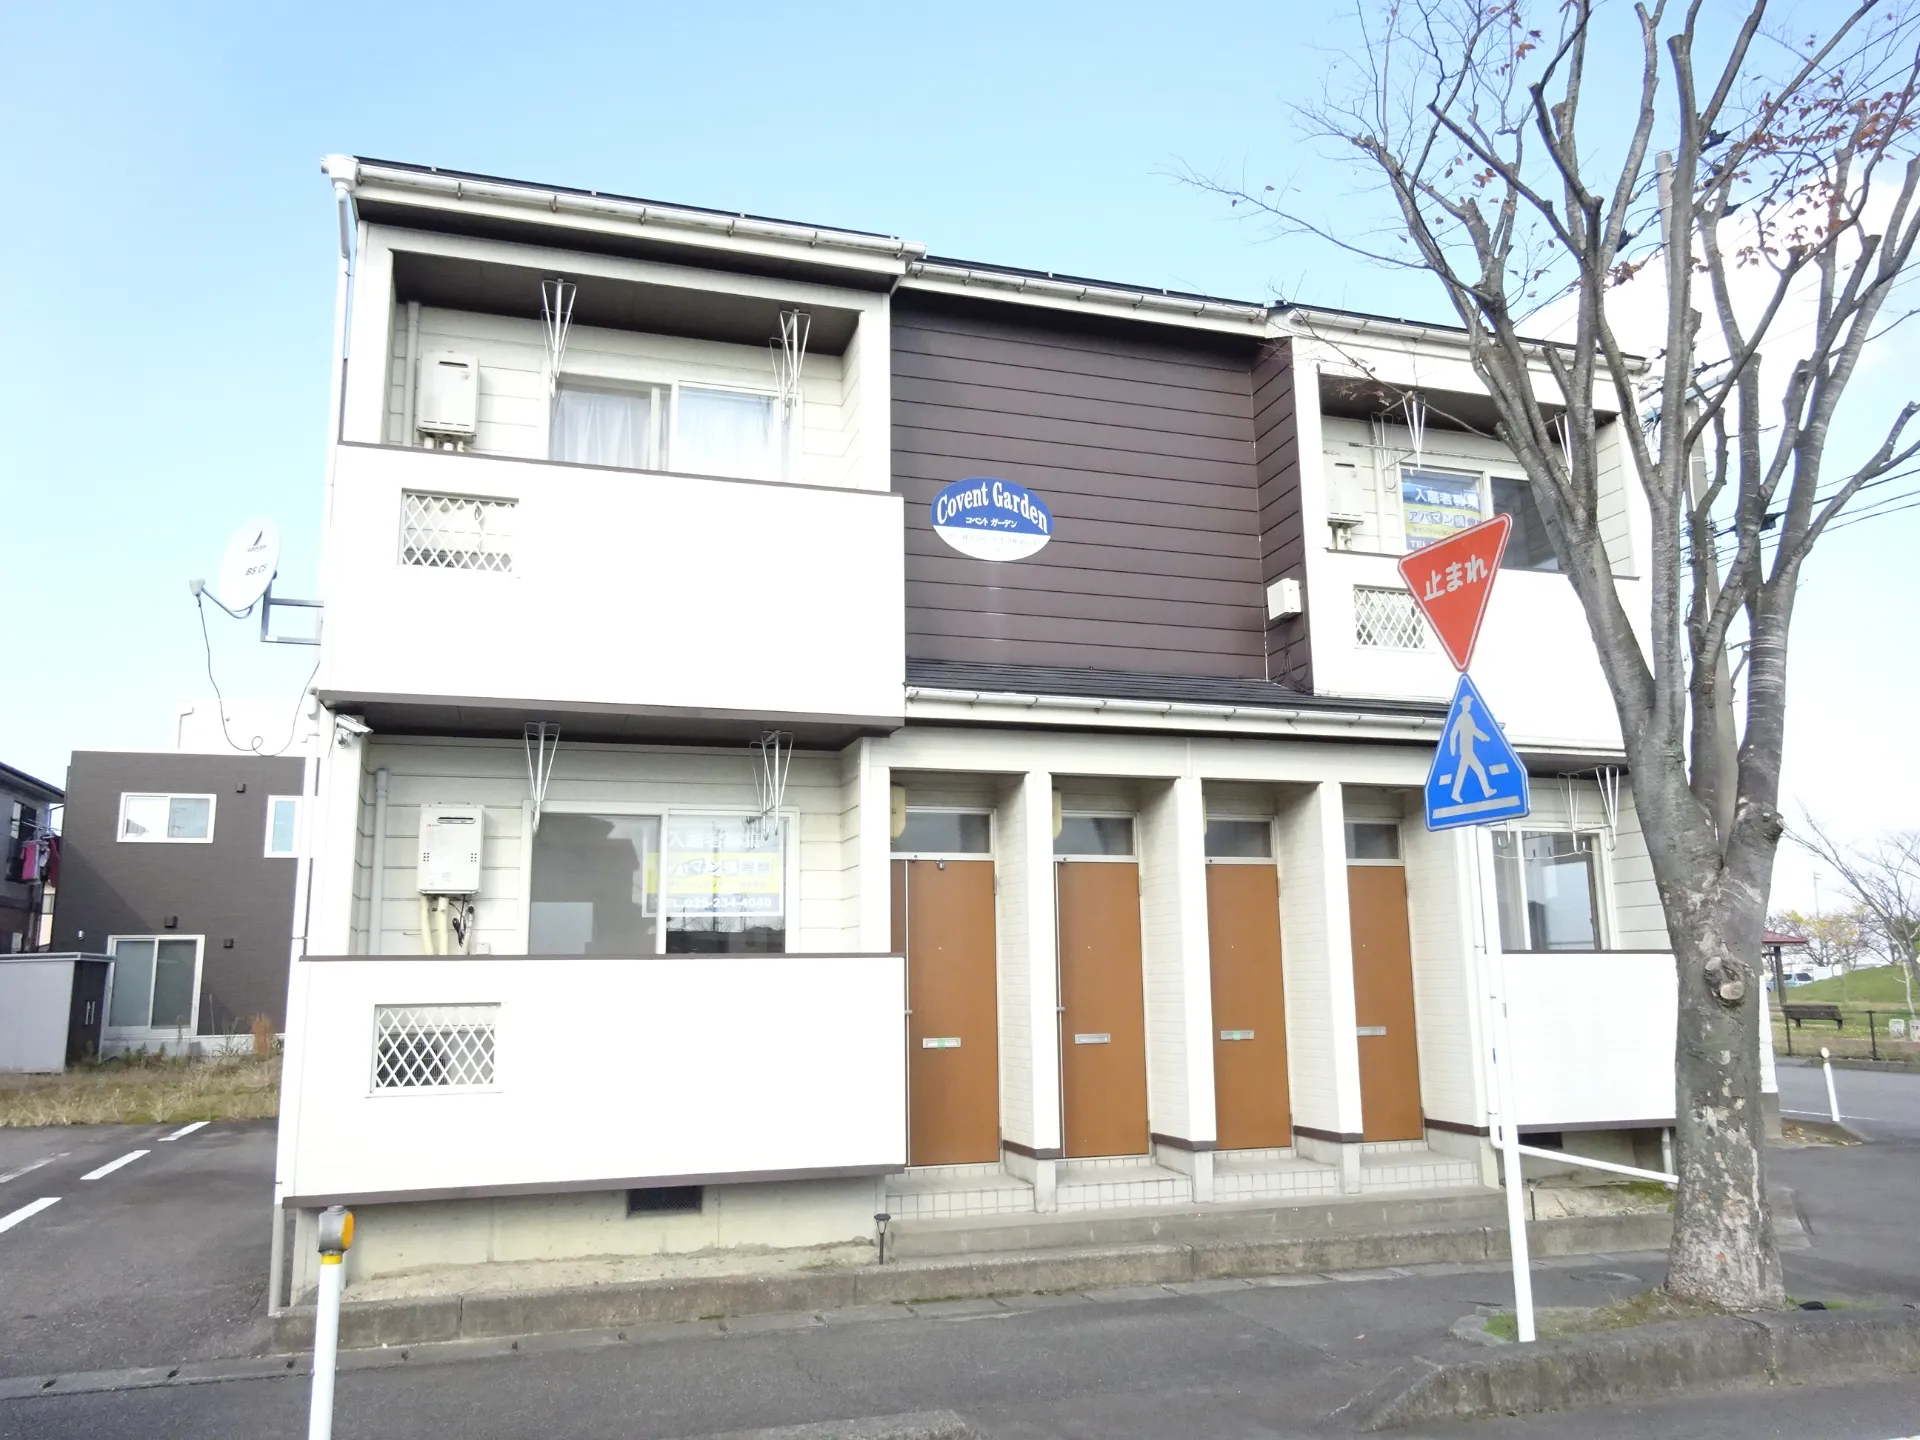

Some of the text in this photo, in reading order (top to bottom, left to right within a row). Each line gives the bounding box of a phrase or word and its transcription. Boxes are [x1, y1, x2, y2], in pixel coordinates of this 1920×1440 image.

[937, 481, 1048, 534] Covent Garden
[965, 517, 1018, 528] コベント ガーデン
[1423, 554, 1488, 601] 止まれ
